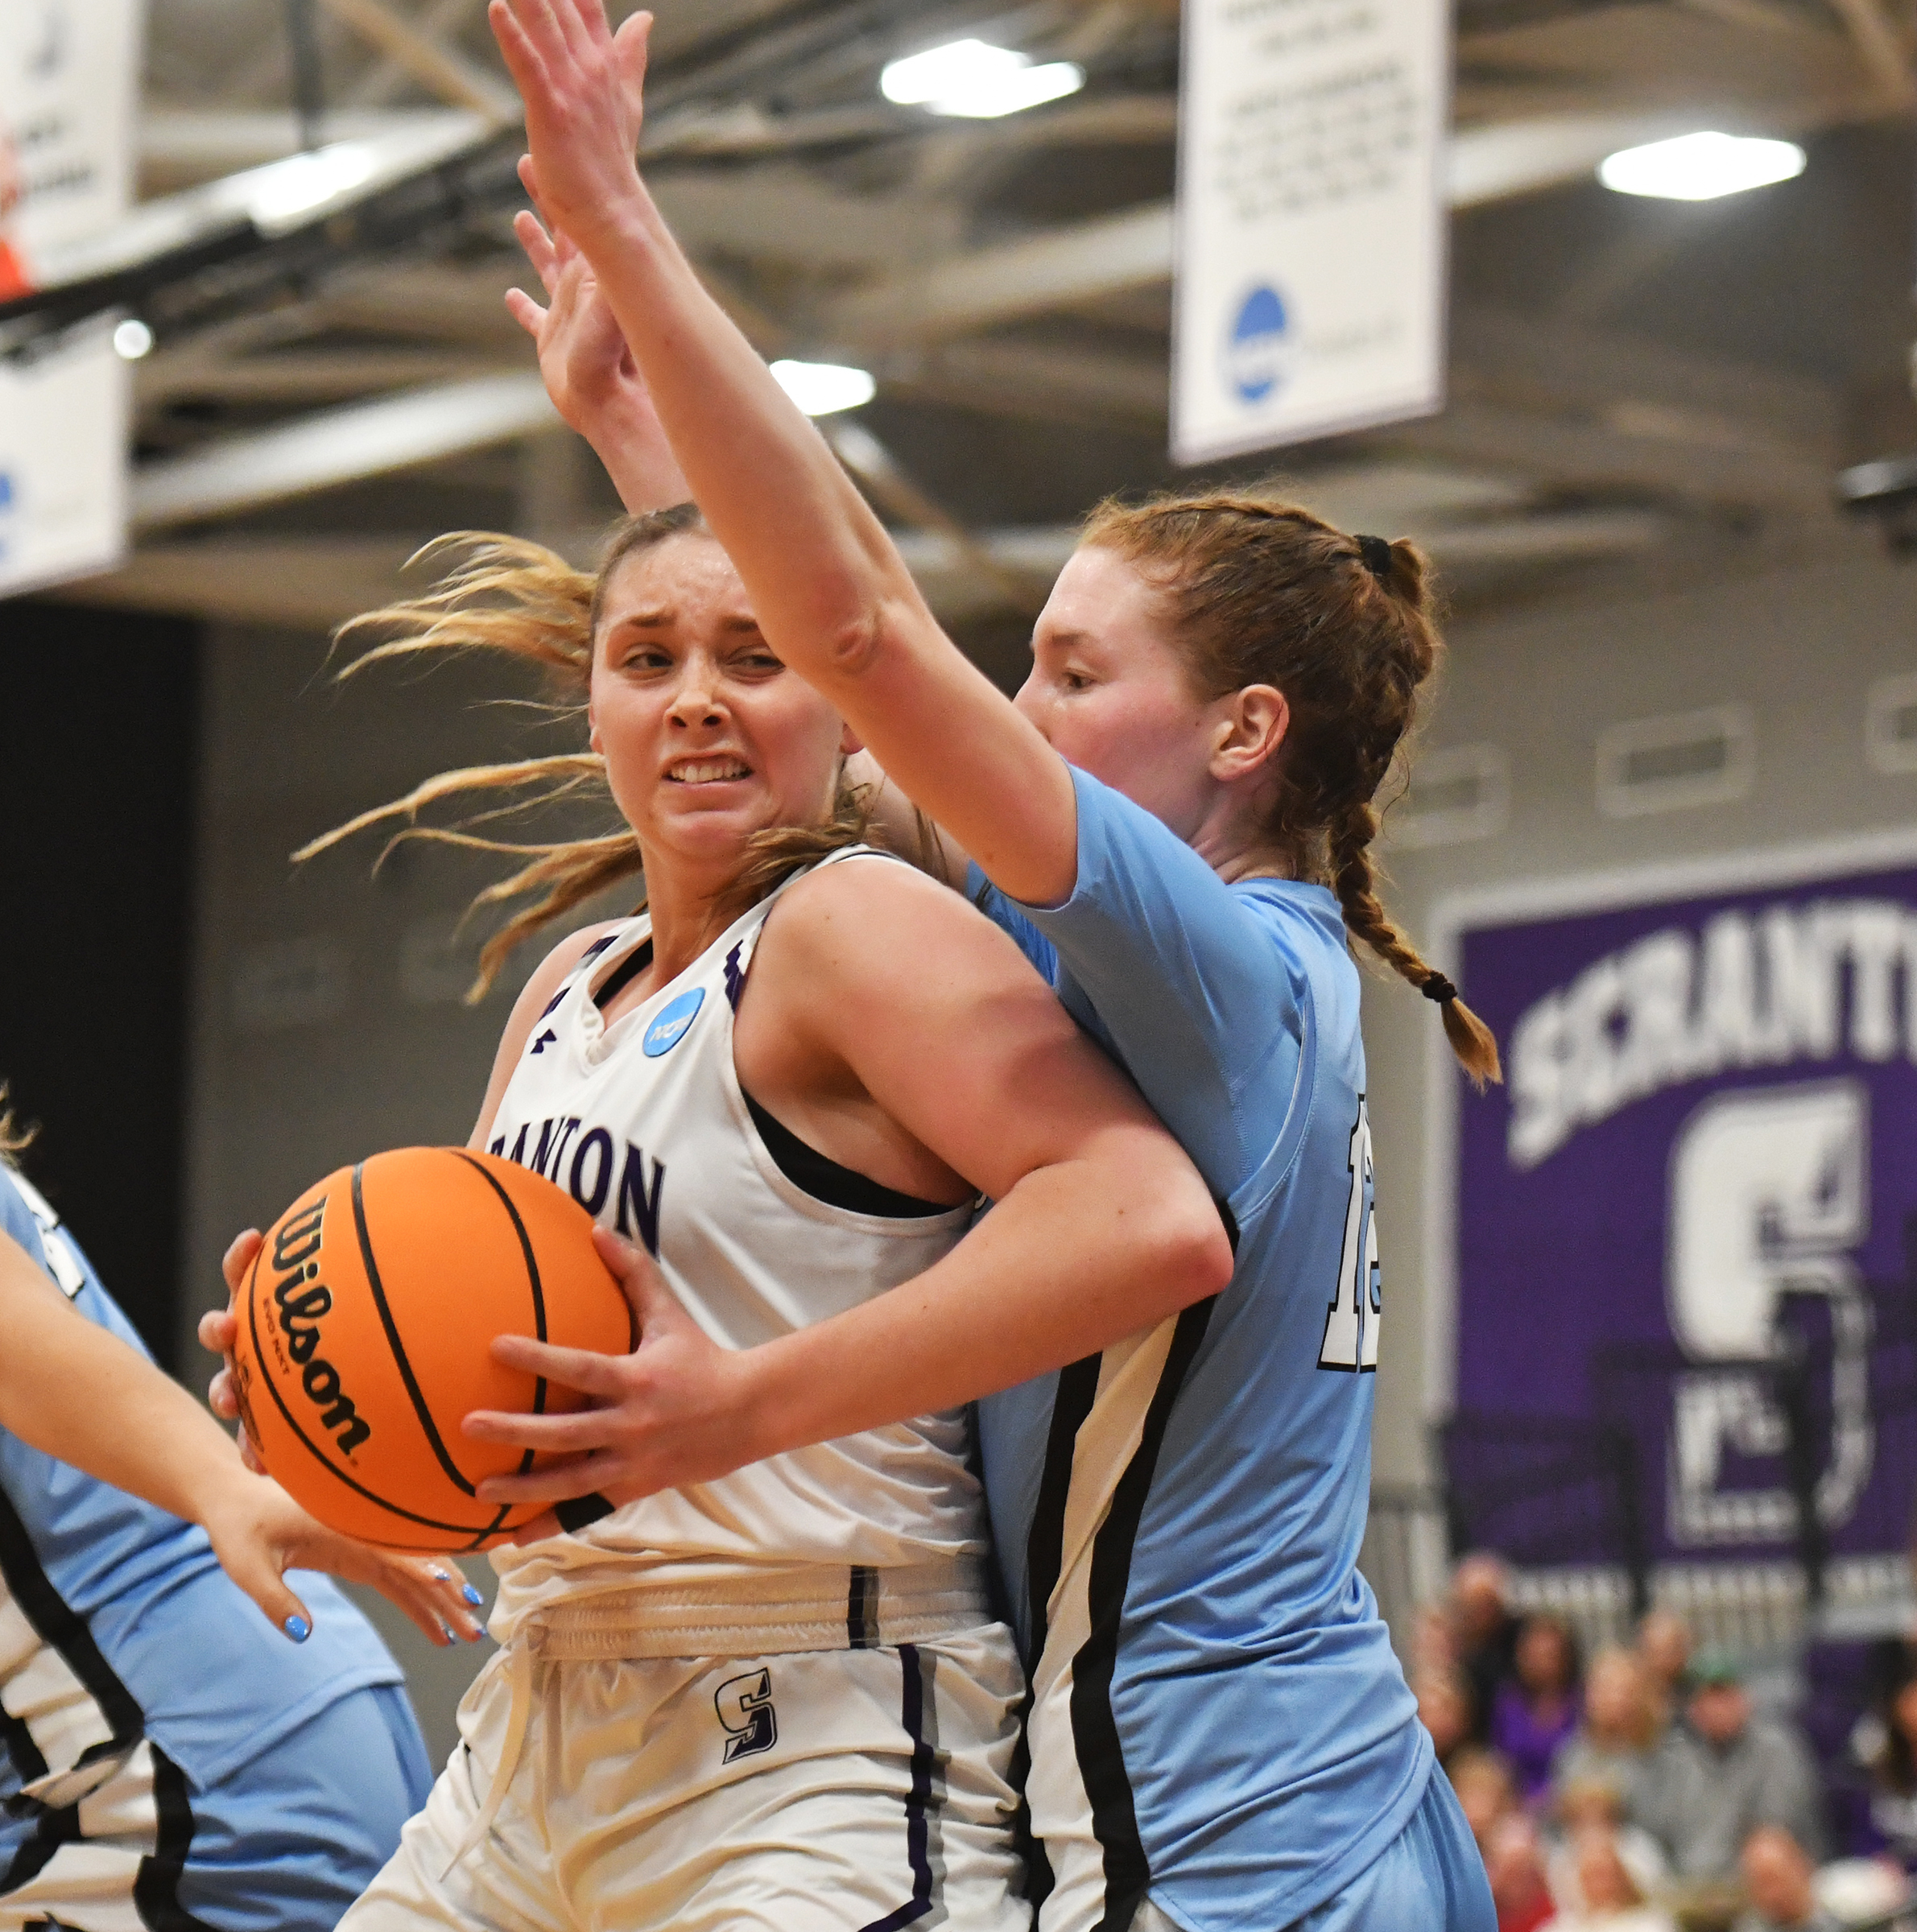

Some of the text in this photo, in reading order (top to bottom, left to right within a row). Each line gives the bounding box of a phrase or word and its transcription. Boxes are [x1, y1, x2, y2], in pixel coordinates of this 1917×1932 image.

[1506, 899, 1917, 1170] SCRANT
[272, 1193, 372, 1456] Wilson
[272, 1338, 290, 1376] NXT
[713, 1666, 778, 1765] S
